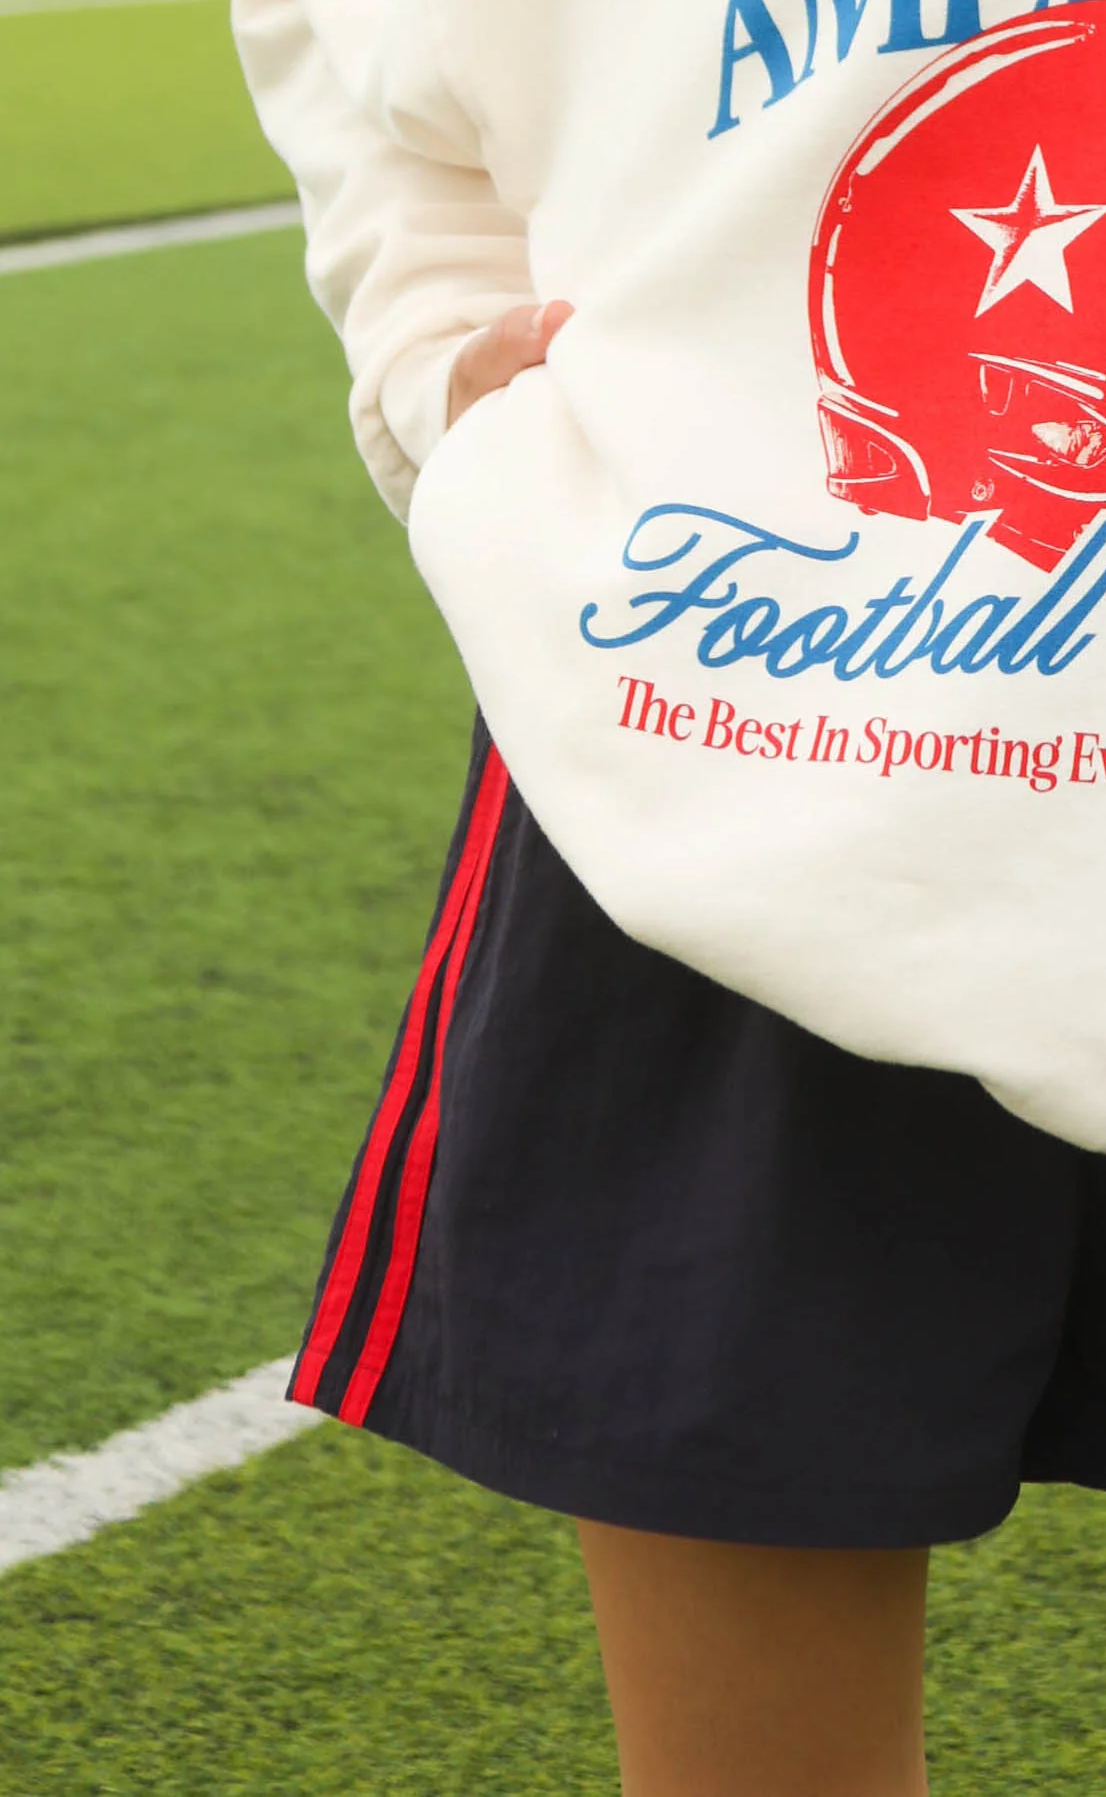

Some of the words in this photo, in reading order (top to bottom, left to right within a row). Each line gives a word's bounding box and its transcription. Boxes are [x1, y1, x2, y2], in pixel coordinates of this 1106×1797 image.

[616, 675, 697, 743] The
[701, 696, 802, 763] Best
[807, 714, 851, 764] In
[855, 717, 1064, 793] Sporting
